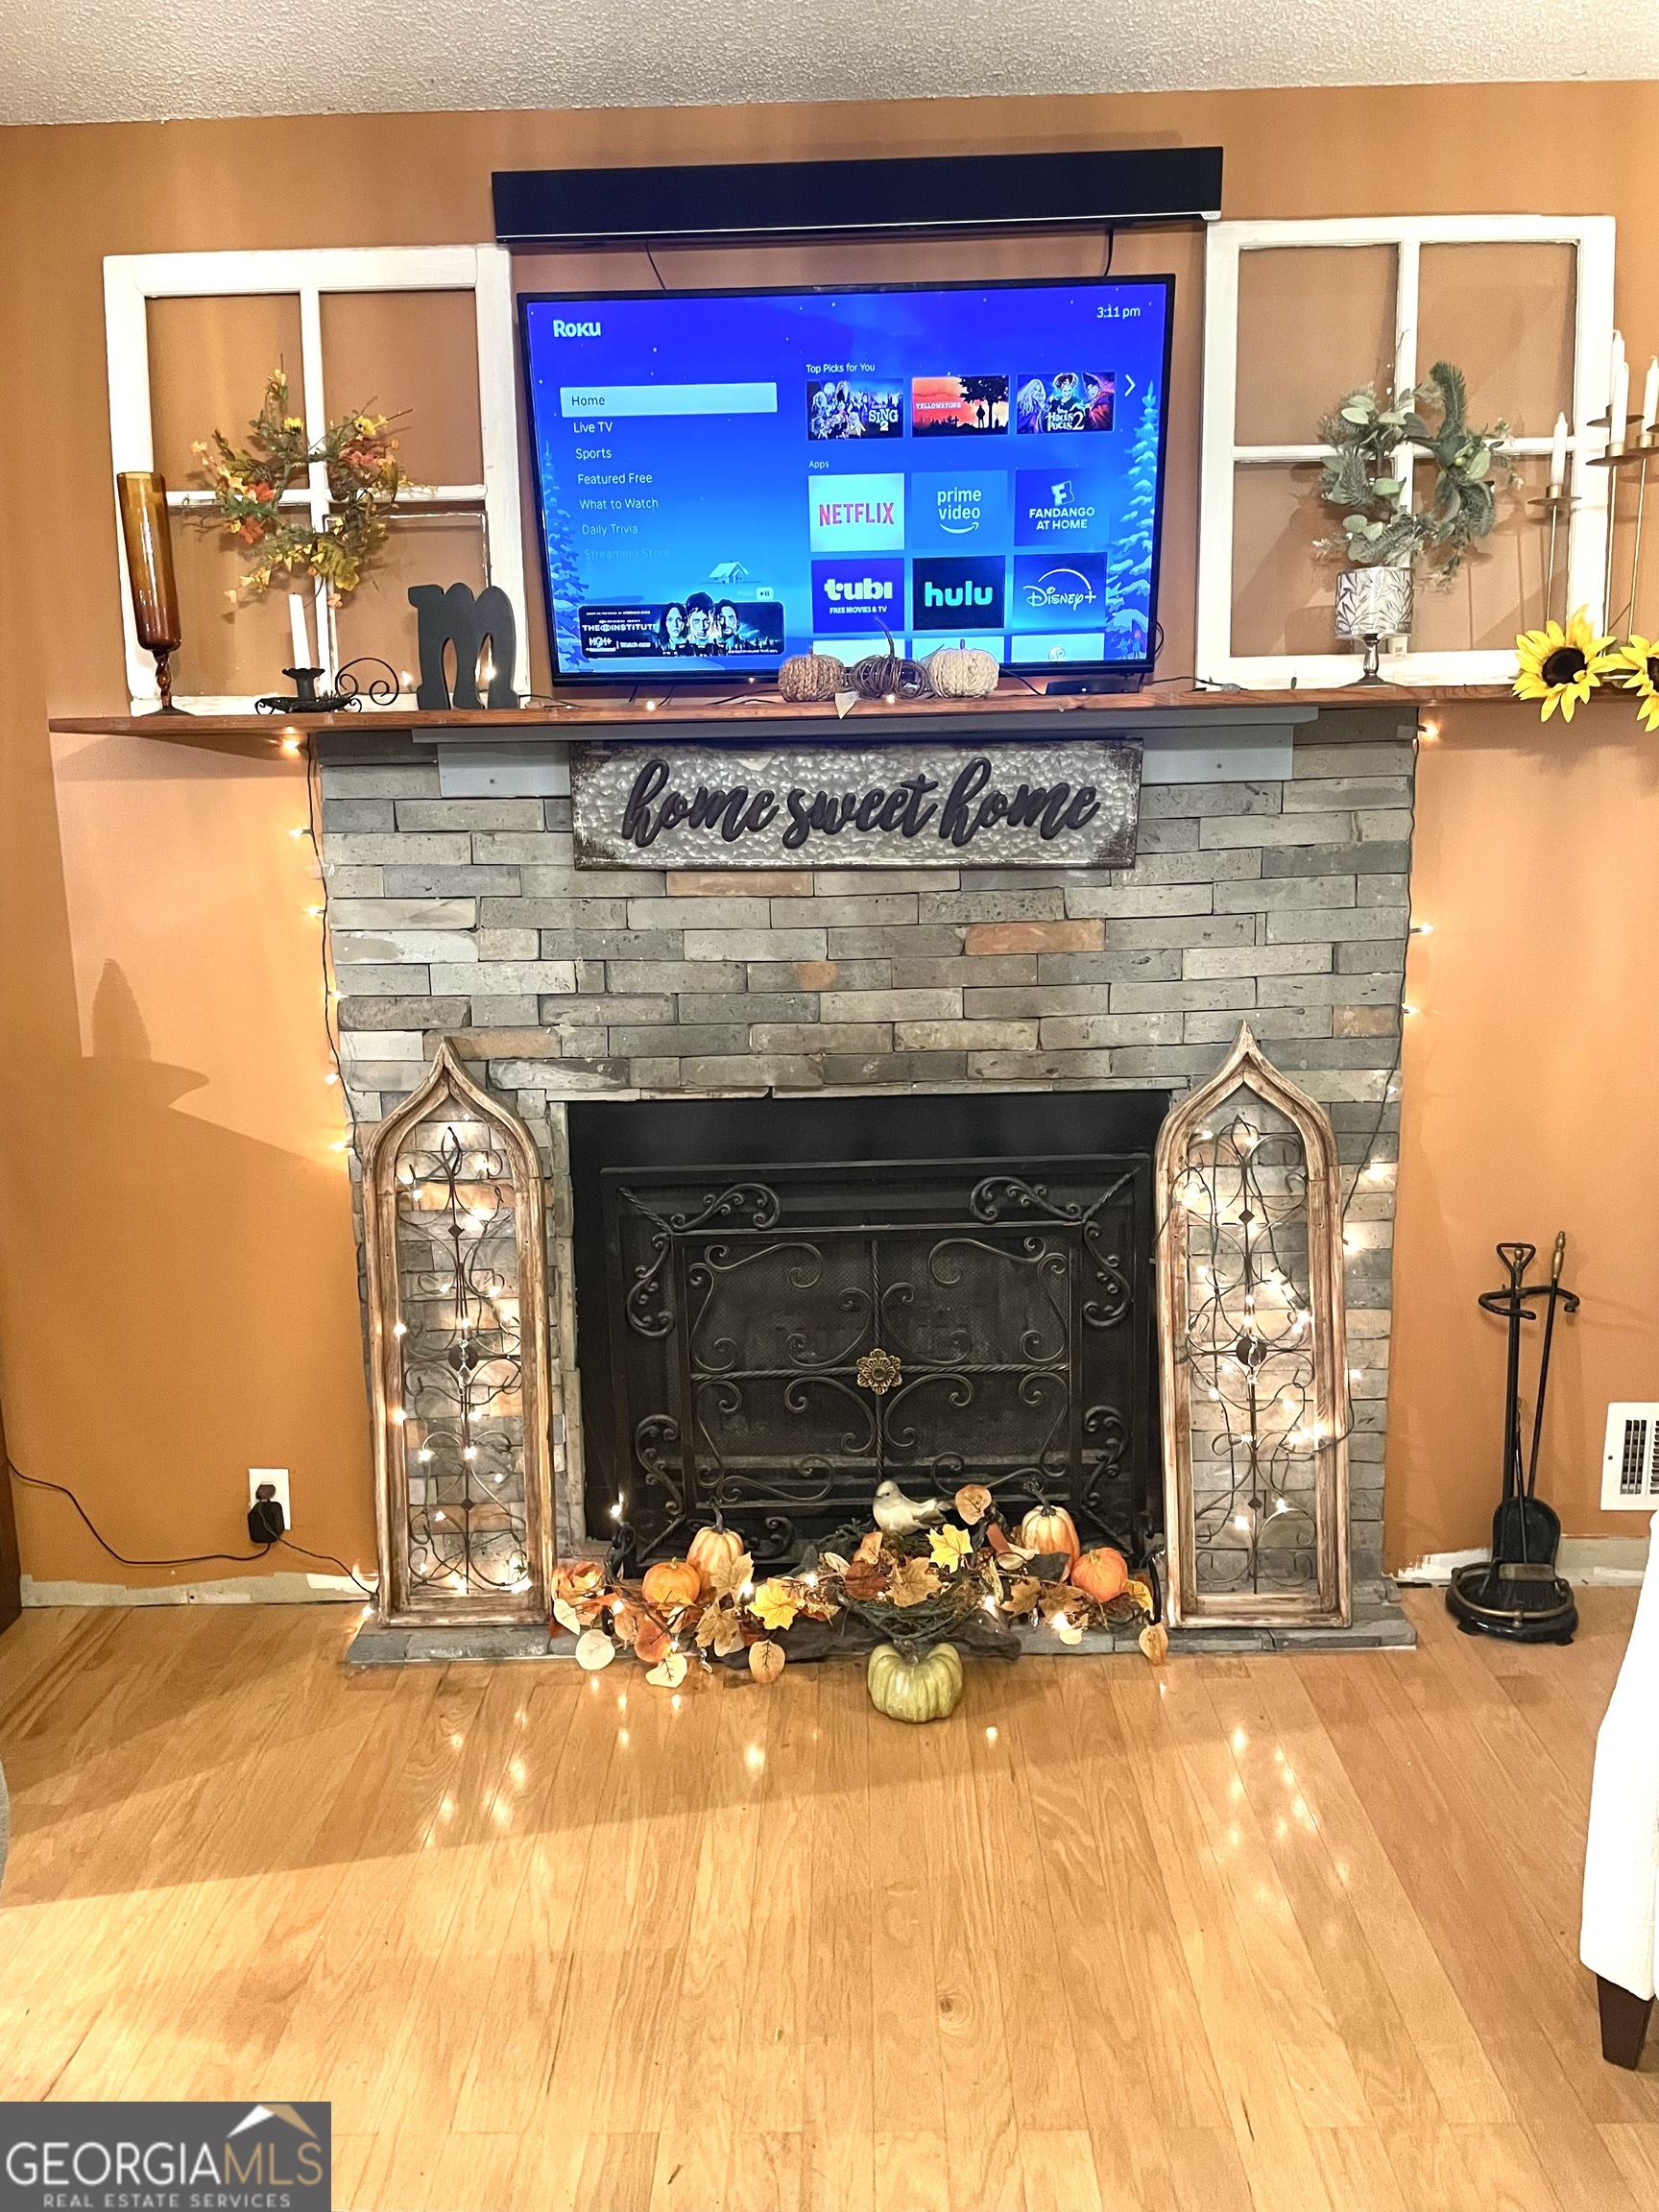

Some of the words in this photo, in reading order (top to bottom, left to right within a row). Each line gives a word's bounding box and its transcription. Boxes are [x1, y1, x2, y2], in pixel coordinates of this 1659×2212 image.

[1096, 306, 1119, 318] 3:11
[1122, 308, 1141, 320] pm
[806, 364, 821, 374] Top
[823, 363, 844, 373] Picks
[846, 363, 857, 372] for
[860, 363, 876, 372] You
[571, 395, 606, 406] Home
[573, 422, 594, 433] Live
[598, 421, 613, 432] TV
[880, 421, 889, 431] 2
[1072, 411, 1084, 430] 2
[576, 448, 612, 461] Sports
[808, 460, 830, 470] Apps
[578, 473, 625, 484] Featured
[628, 472, 653, 483] Free
[937, 487, 982, 505] prime
[579, 499, 607, 509] What
[611, 500, 622, 509] to
[624, 498, 658, 508] Watch
[819, 502, 894, 526] NETFLIX
[938, 505, 980, 519] video
[1029, 507, 1095, 518] FANDANGO
[582, 524, 607, 537] Daily
[610, 523, 638, 534] Trivia
[1036, 520, 1050, 530] AT
[1052, 519, 1088, 529] HOME
[824, 578, 893, 601] tubi
[925, 581, 993, 607] hulu
[620, 758, 780, 848] home
[781, 773, 938, 849] sweet
[938, 757, 1100, 847] home
